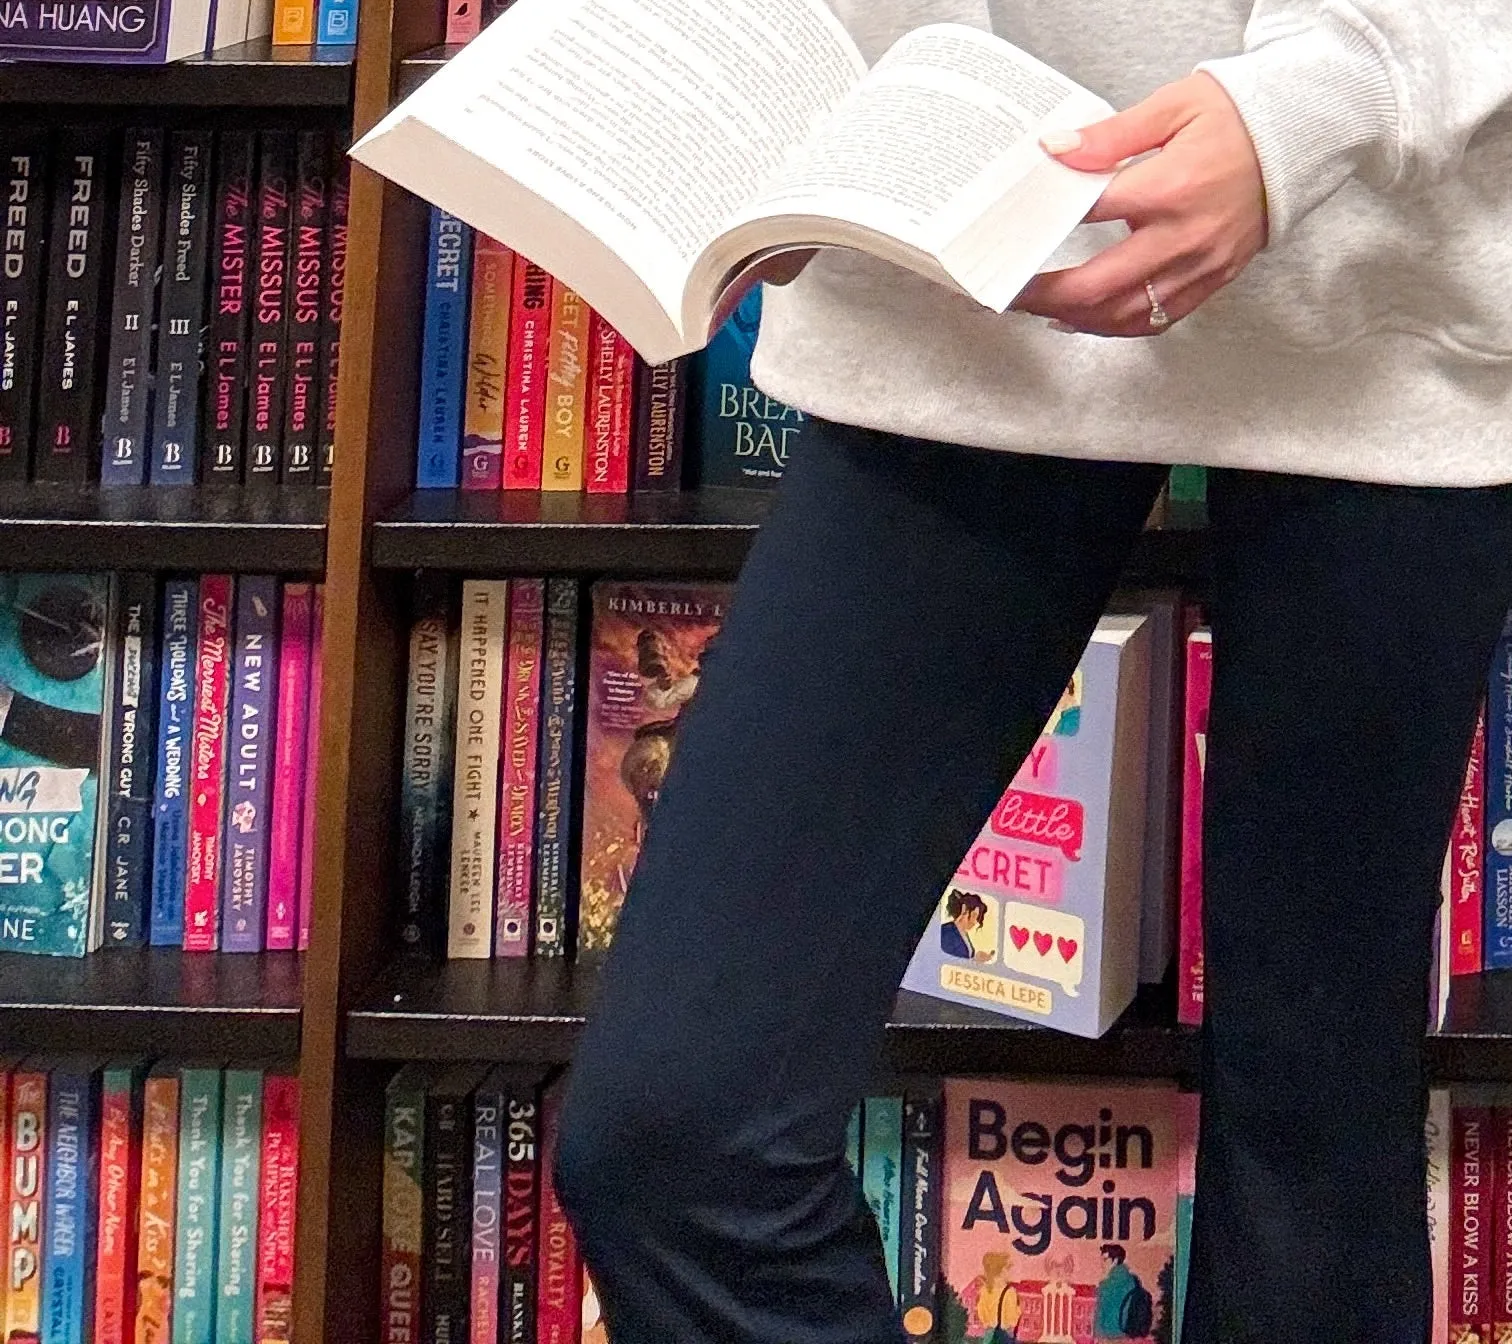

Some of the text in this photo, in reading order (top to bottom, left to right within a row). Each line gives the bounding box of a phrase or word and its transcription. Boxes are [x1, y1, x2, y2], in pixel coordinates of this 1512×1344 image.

[66, 156, 94, 279] FREED
[220, 224, 245, 315] MISTER
[238, 634, 264, 792] NEW ADULT
[998, 793, 1076, 841] little
[948, 969, 1046, 1008] JESSICA LEPE
[505, 1099, 536, 1269] 365 DAYS
[968, 1098, 1154, 1187] Begin
[10, 1111, 40, 1291] BUMP
[961, 1169, 1157, 1256] Again
